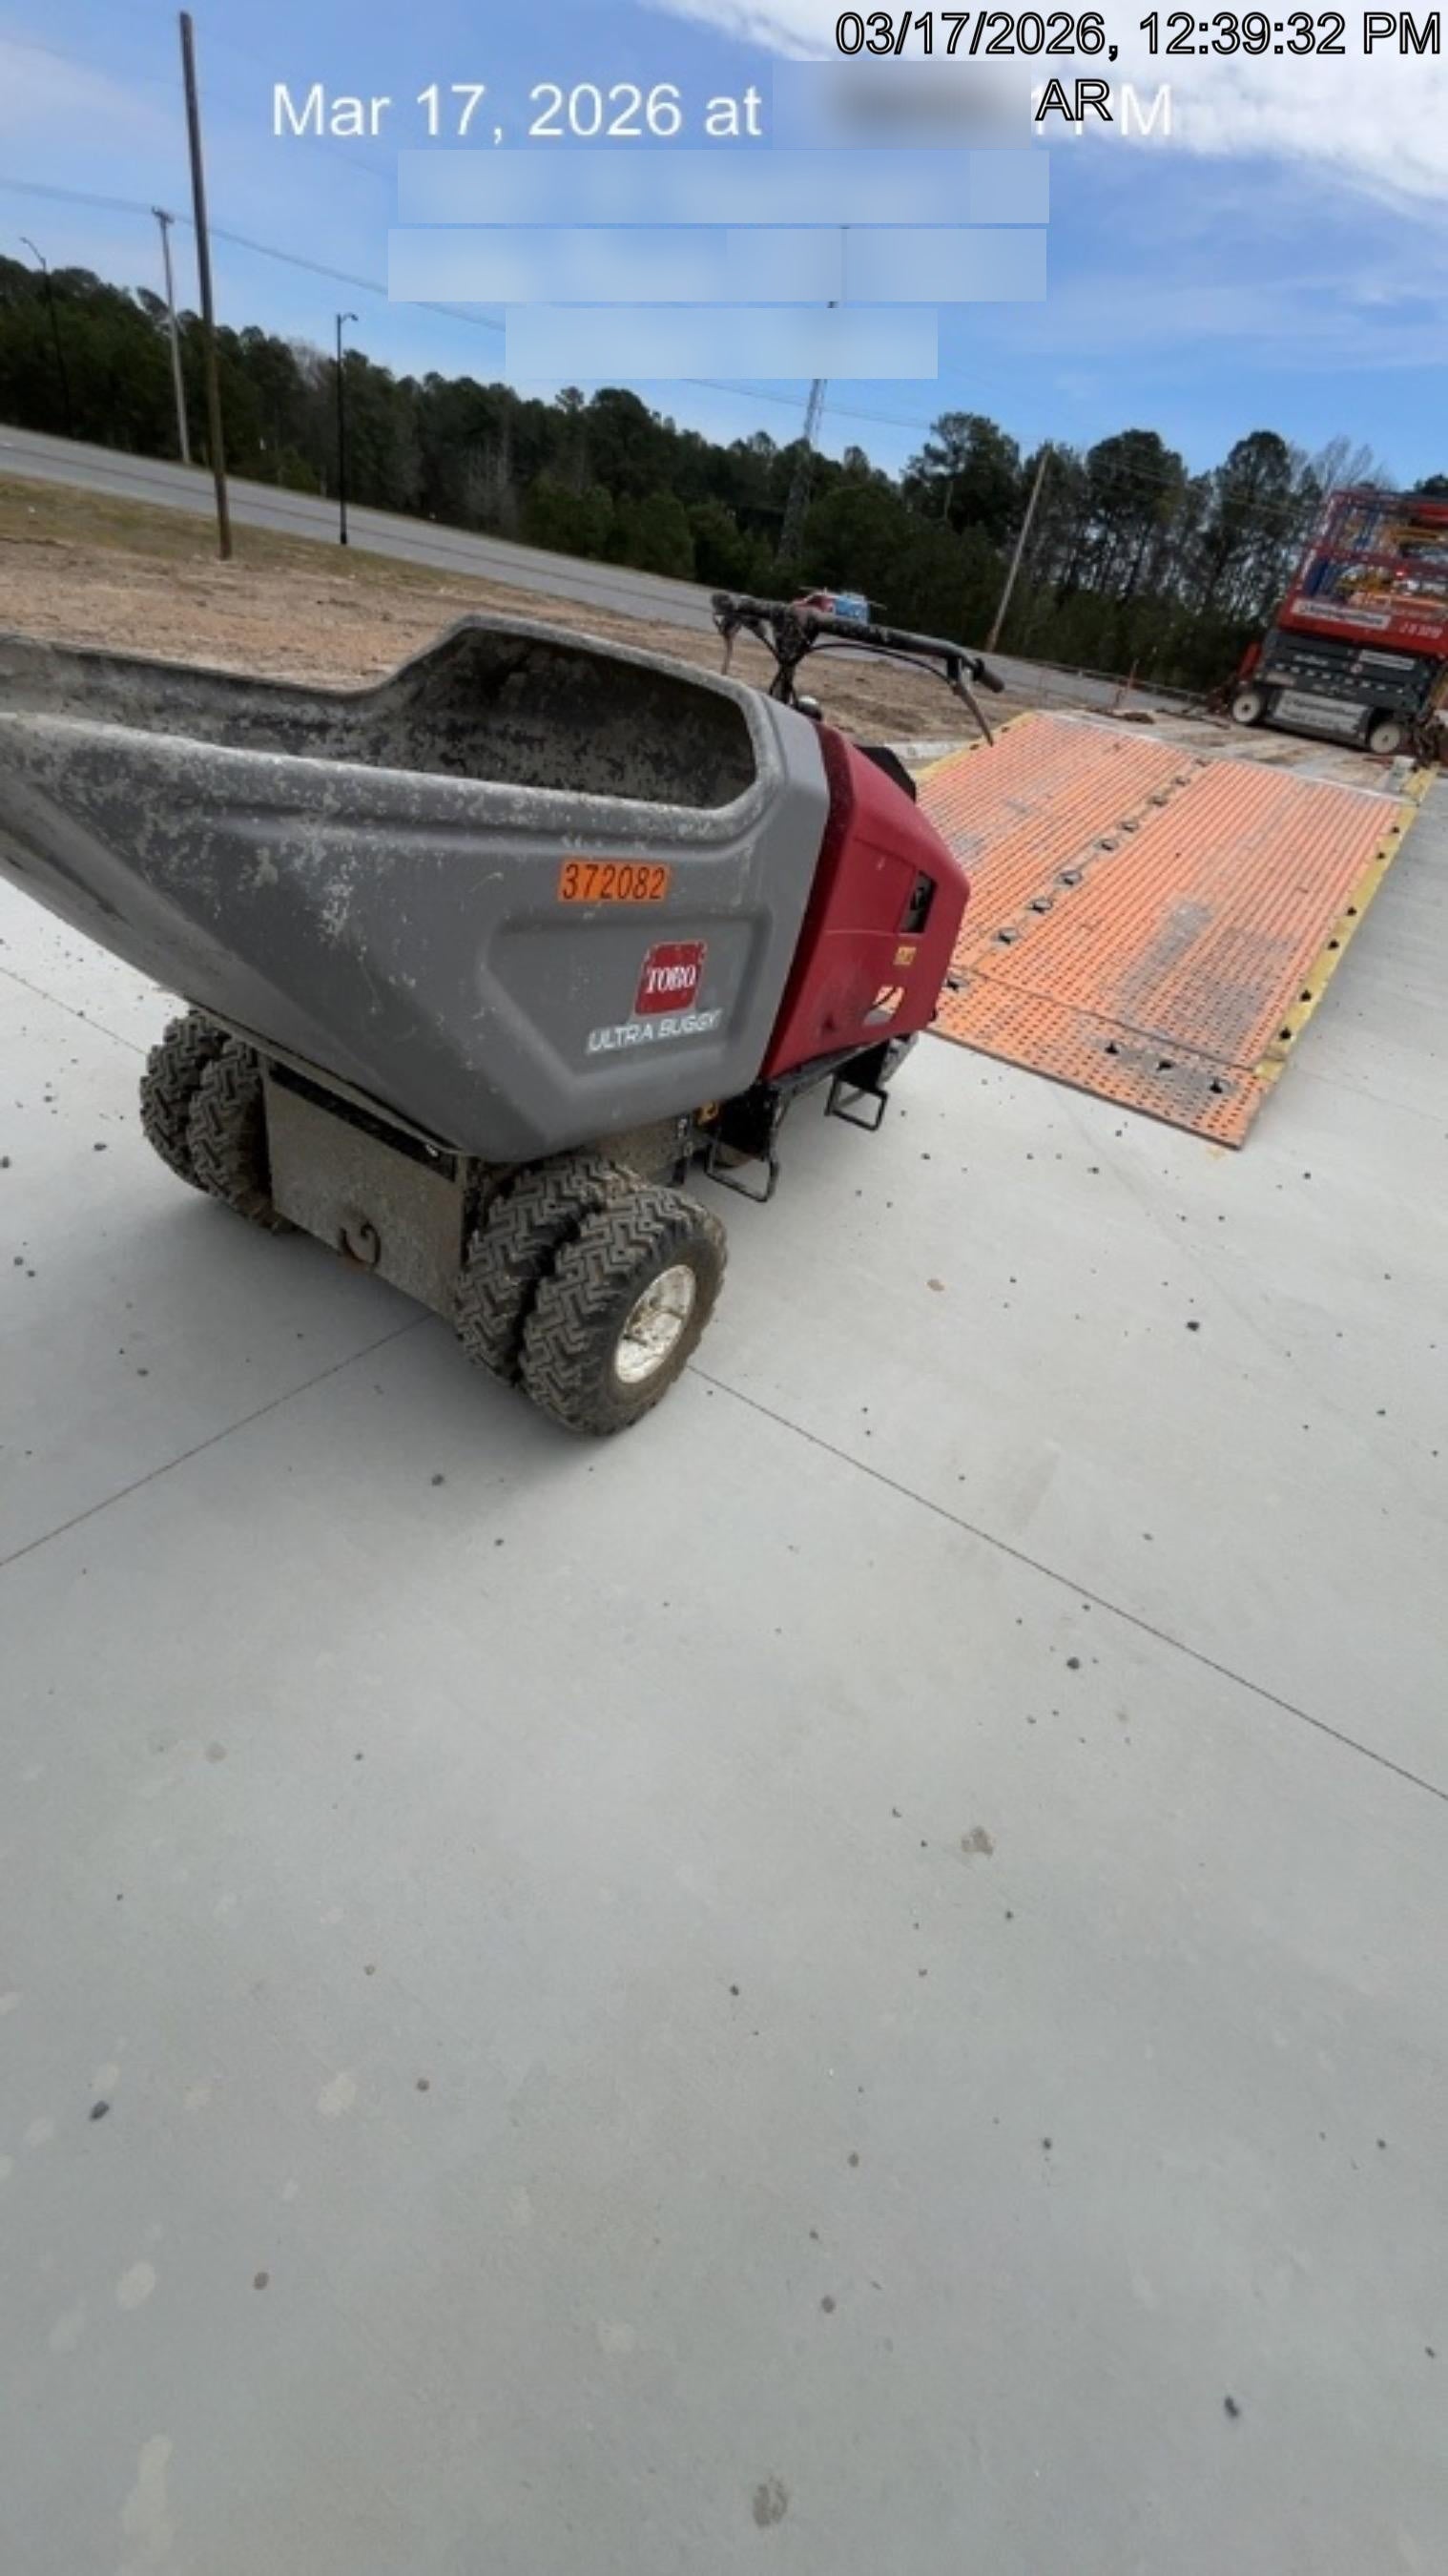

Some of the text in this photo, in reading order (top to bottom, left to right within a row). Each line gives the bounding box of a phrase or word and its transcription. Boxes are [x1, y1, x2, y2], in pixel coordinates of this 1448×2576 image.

[563, 863, 665, 900] 372082
[646, 964, 697, 994] TORO
[587, 1008, 722, 1054] ULTRA BUGGY
